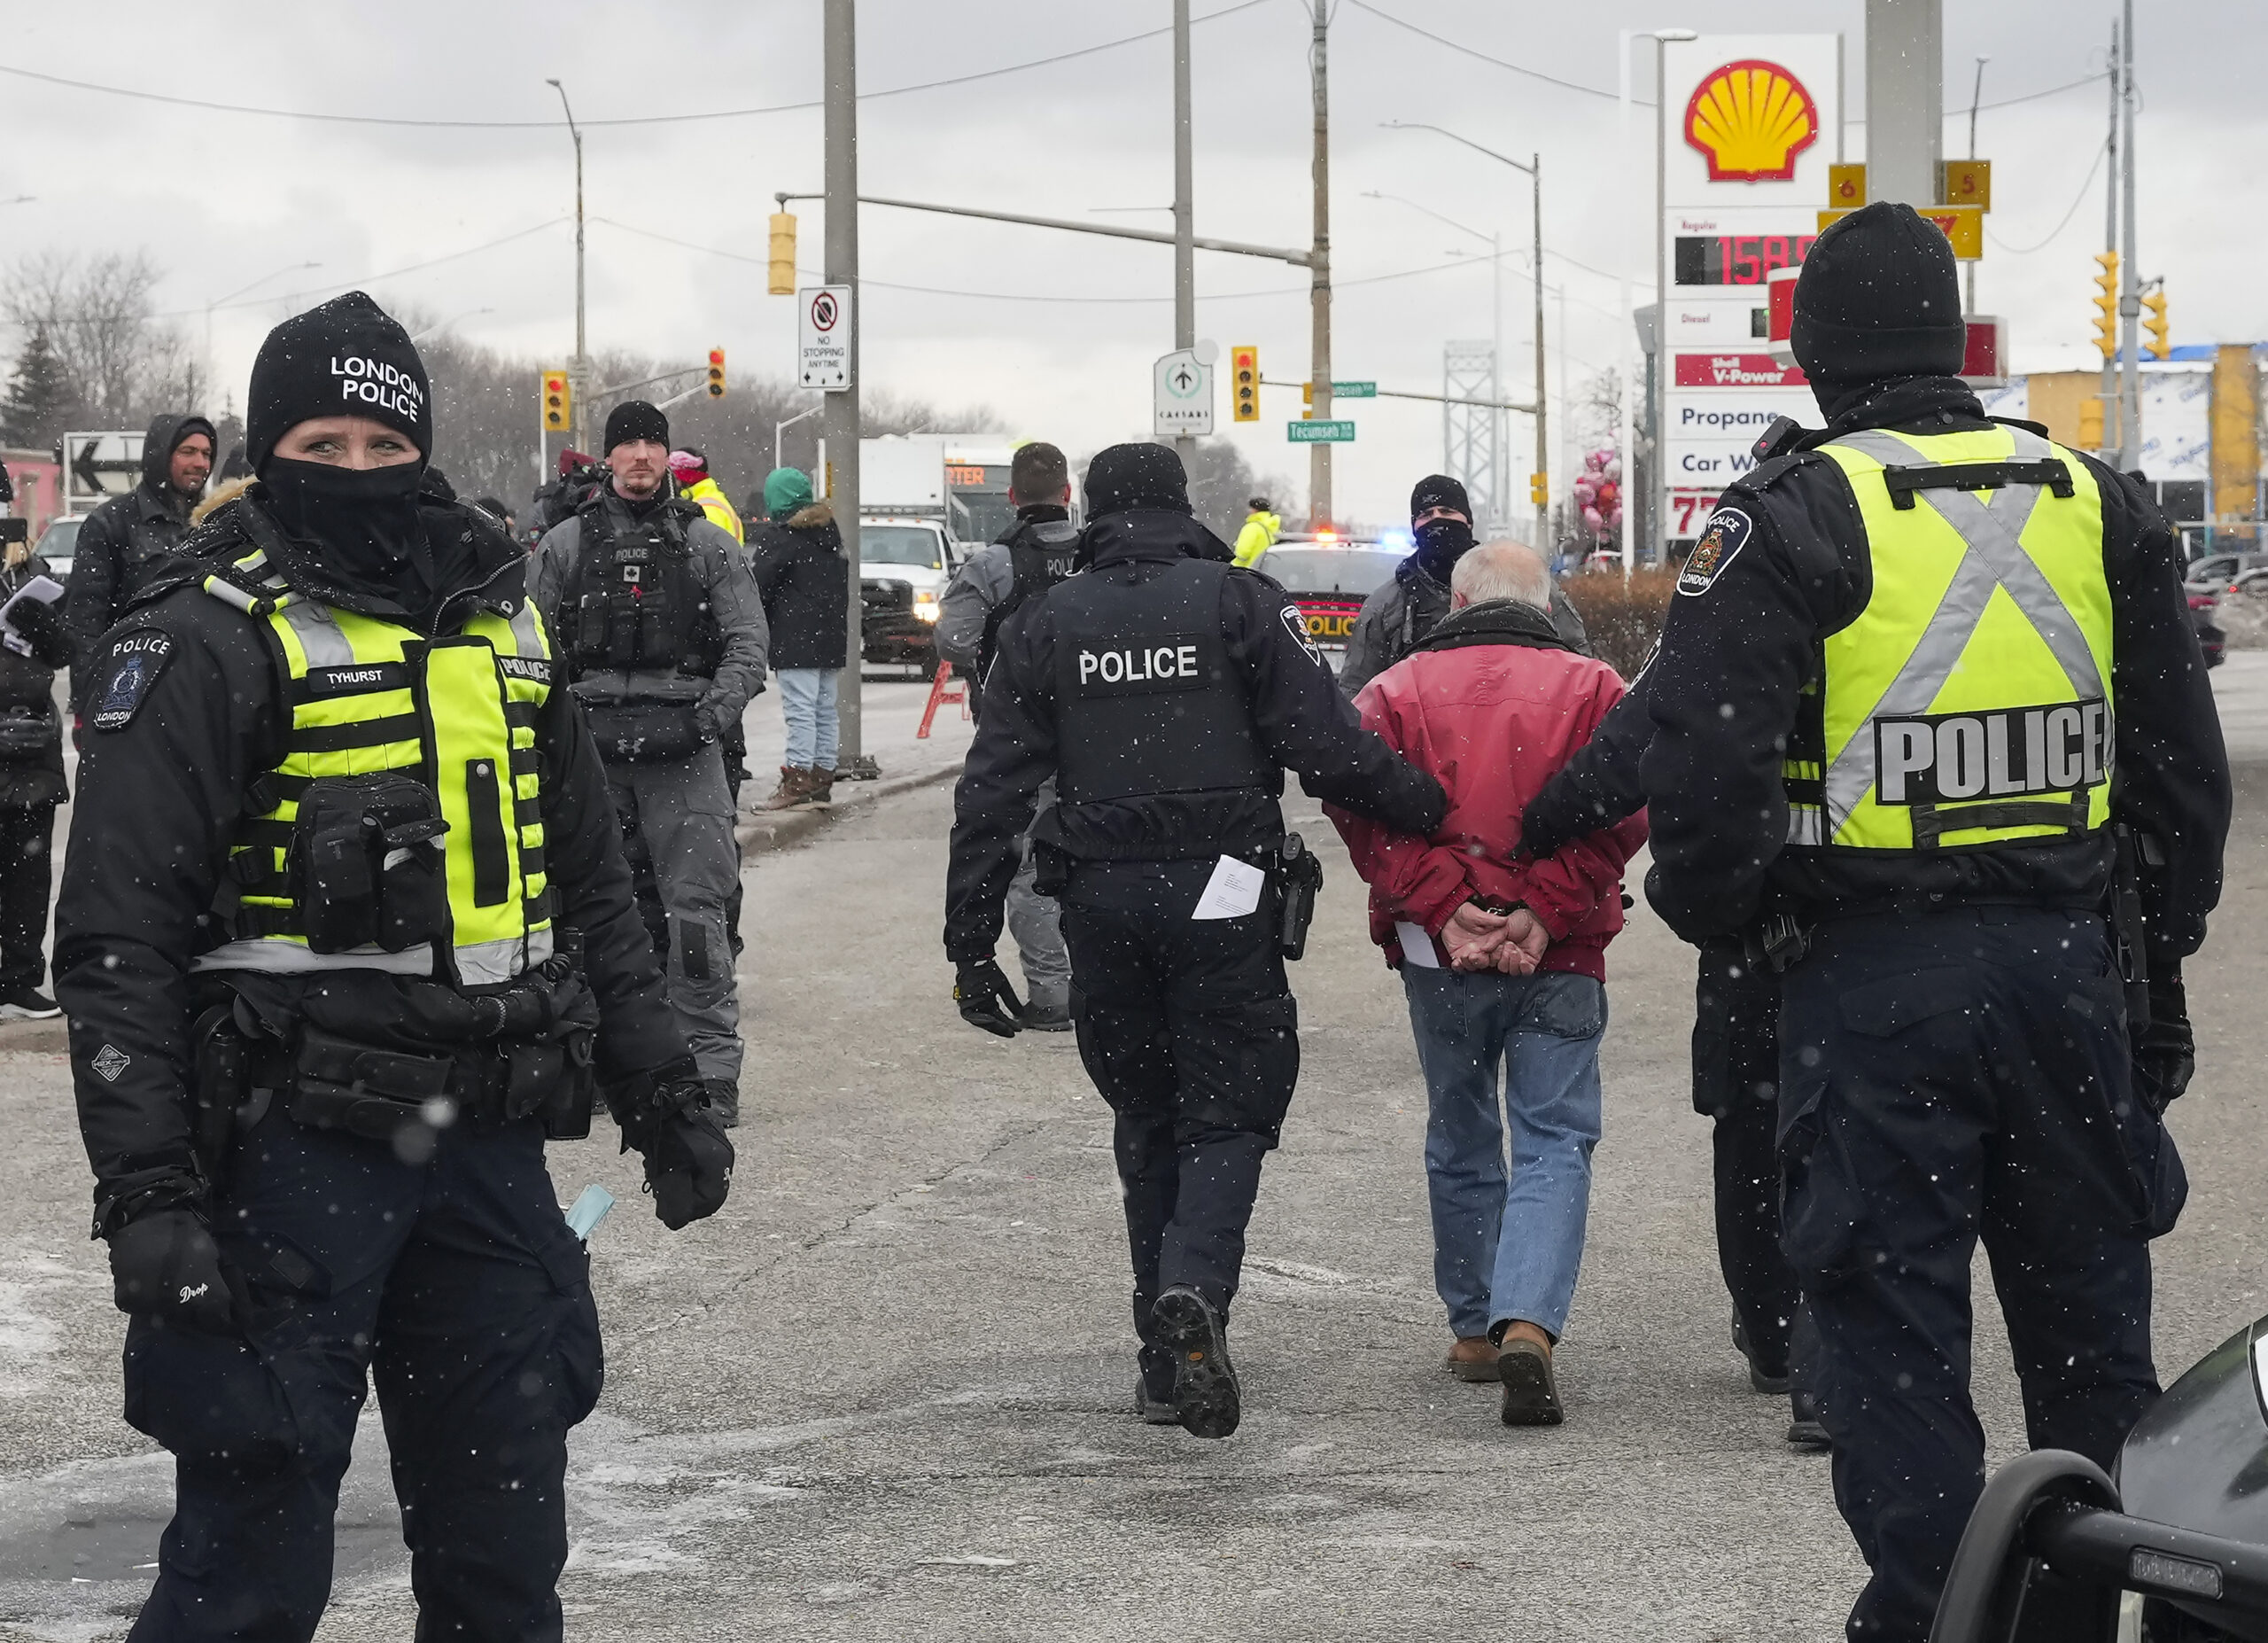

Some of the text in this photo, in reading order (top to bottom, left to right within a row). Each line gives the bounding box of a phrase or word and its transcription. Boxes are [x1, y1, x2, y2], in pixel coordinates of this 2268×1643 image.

[1840, 180, 1856, 199] 6
[1961, 175, 1976, 194] 5
[1681, 313, 1711, 323] Diesel
[818, 336, 830, 345] NO
[804, 347, 844, 357] STOPPING
[808, 359, 839, 368] ANYTIME
[1712, 356, 1740, 368] Shell
[331, 356, 423, 405] LONDON
[1713, 369, 1784, 384] V-Power
[342, 379, 418, 423] POLICE
[1682, 409, 1779, 430] Propane
[1290, 424, 1340, 439] Tecumseh
[1682, 454, 1760, 471] Car W
[616, 548, 648, 560] POLICE
[1682, 573, 1711, 586] LONDON
[1304, 615, 1356, 636] OLIC
[112, 638, 170, 657] POLICE
[501, 658, 551, 681] POLICE
[1079, 645, 1198, 685] POLICE
[327, 670, 382, 684] TYHURST
[97, 712, 132, 721] LONDON
[1880, 703, 2103, 801] POLICE
[180, 1282, 209, 1304] Drop
